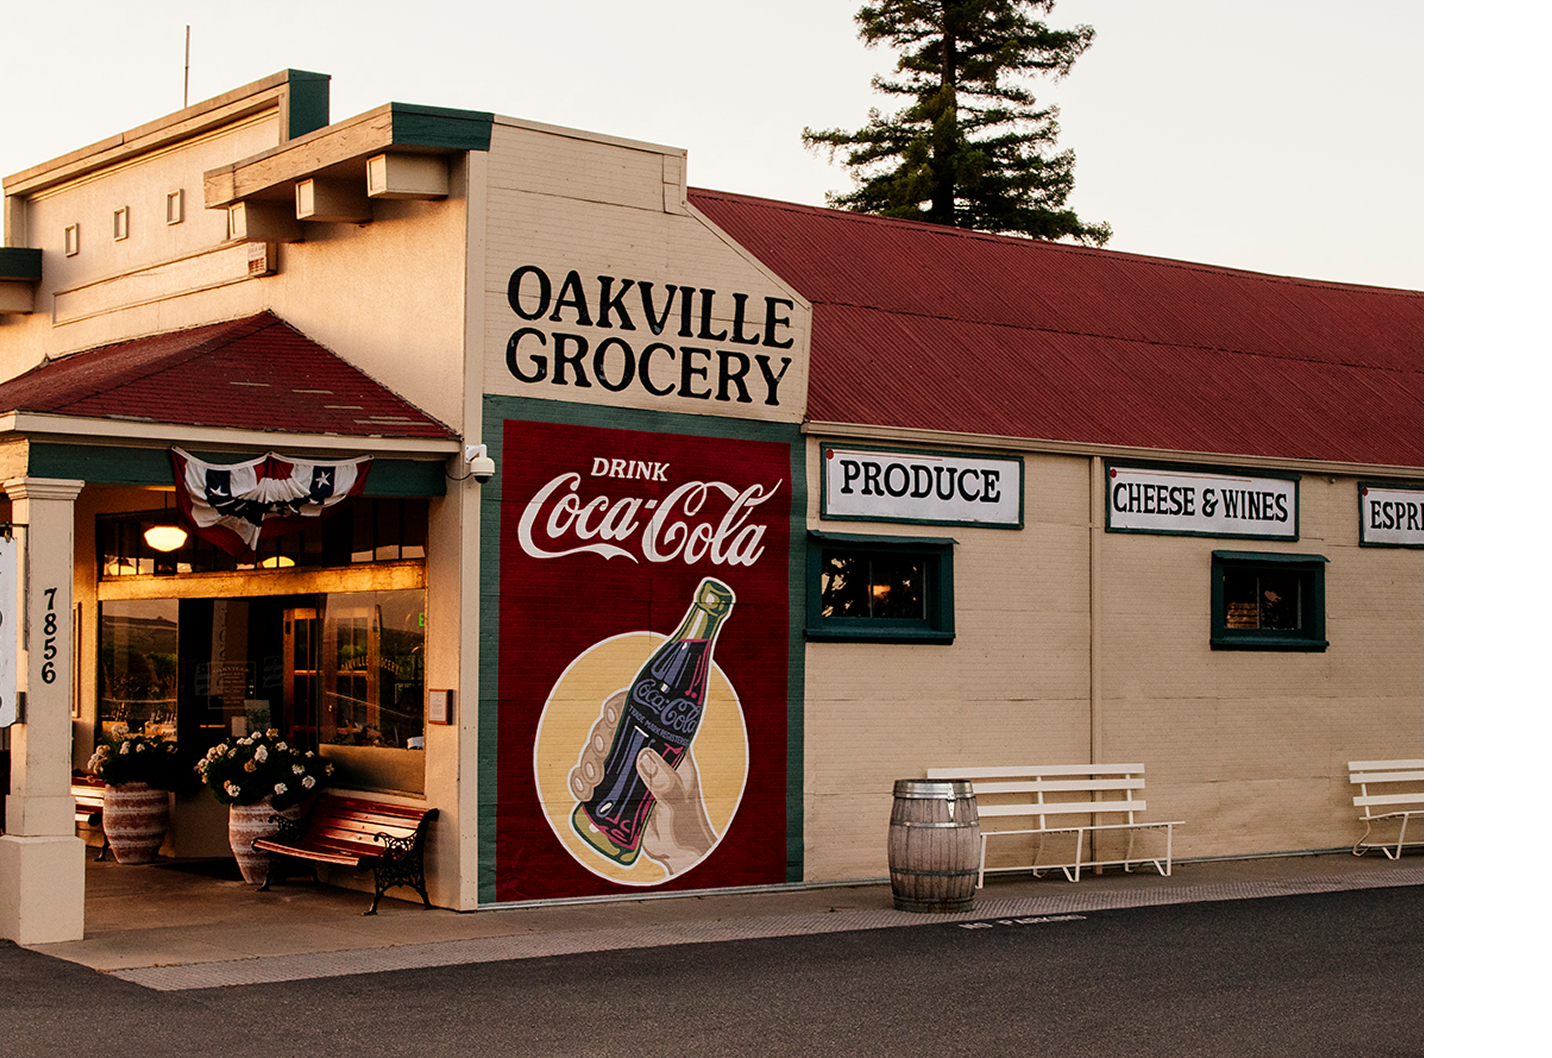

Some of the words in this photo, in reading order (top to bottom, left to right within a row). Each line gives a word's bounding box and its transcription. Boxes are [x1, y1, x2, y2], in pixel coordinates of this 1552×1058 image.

[507, 265, 794, 349] OAKVILLE
[506, 327, 792, 406] GROCERY
[590, 457, 670, 482] DRINK
[839, 459, 1001, 503] PRODUCE
[1113, 482, 1196, 516] CHEESE
[1201, 488, 1219, 518] &
[1220, 489, 1289, 523] WINES
[517, 472, 783, 567] Coca-Cola
[41, 587, 58, 684] 7856
